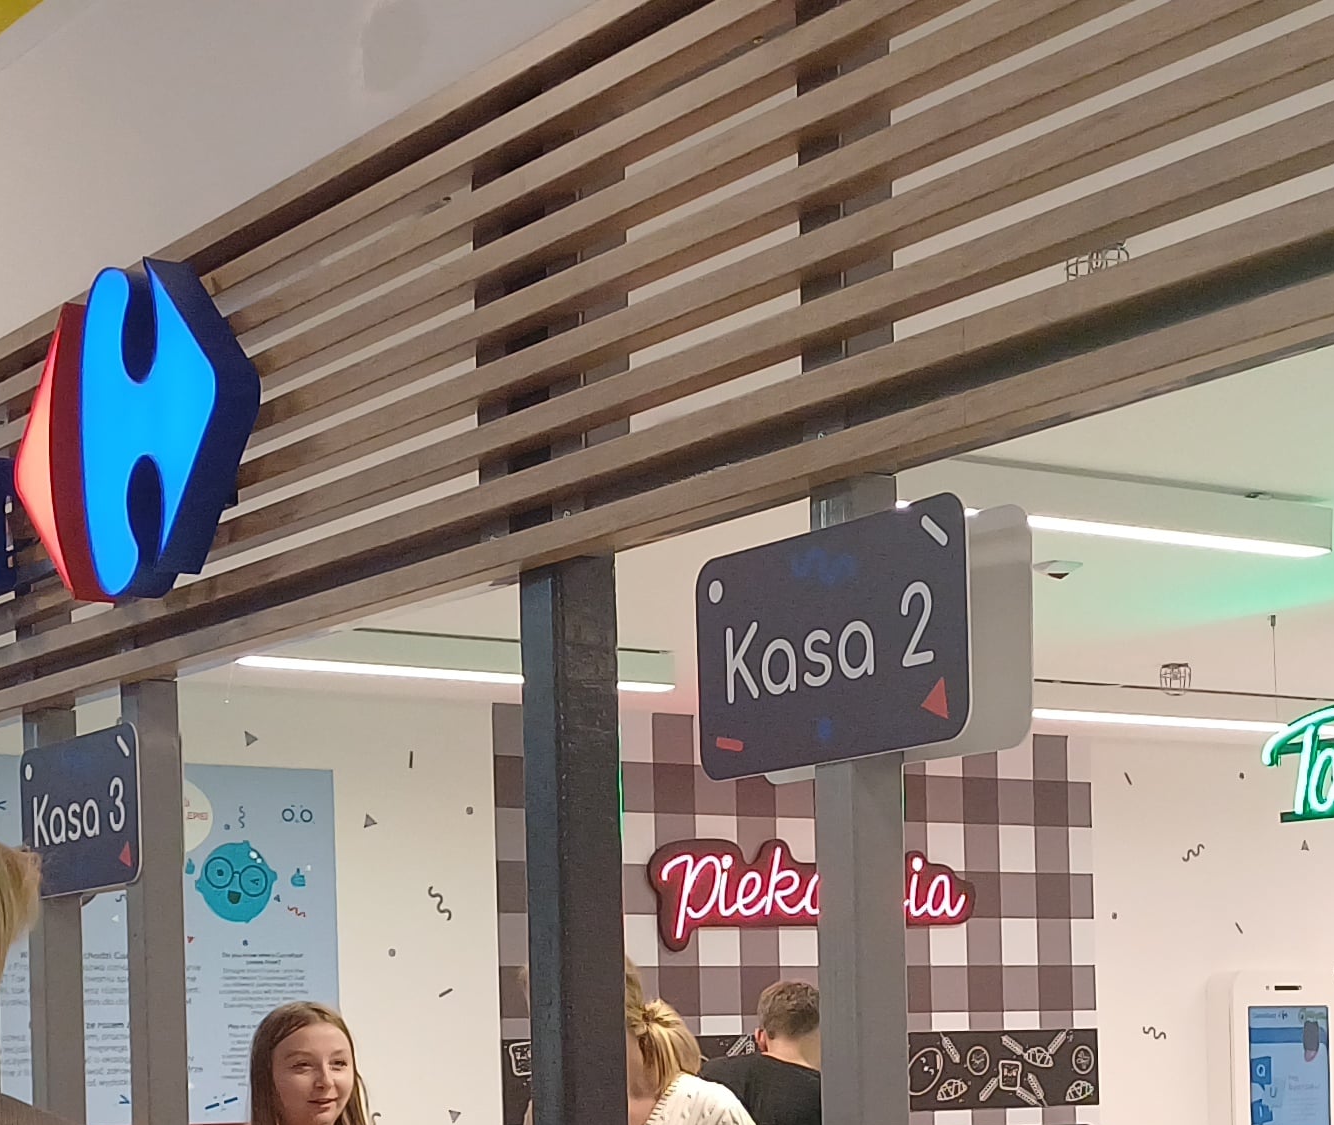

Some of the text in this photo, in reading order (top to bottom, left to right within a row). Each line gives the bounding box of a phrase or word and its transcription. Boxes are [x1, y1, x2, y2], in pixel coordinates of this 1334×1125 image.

[726, 581, 934, 704] Kasa 2
[33, 777, 126, 848] Kasa 3
[661, 846, 966, 940] Piekia
